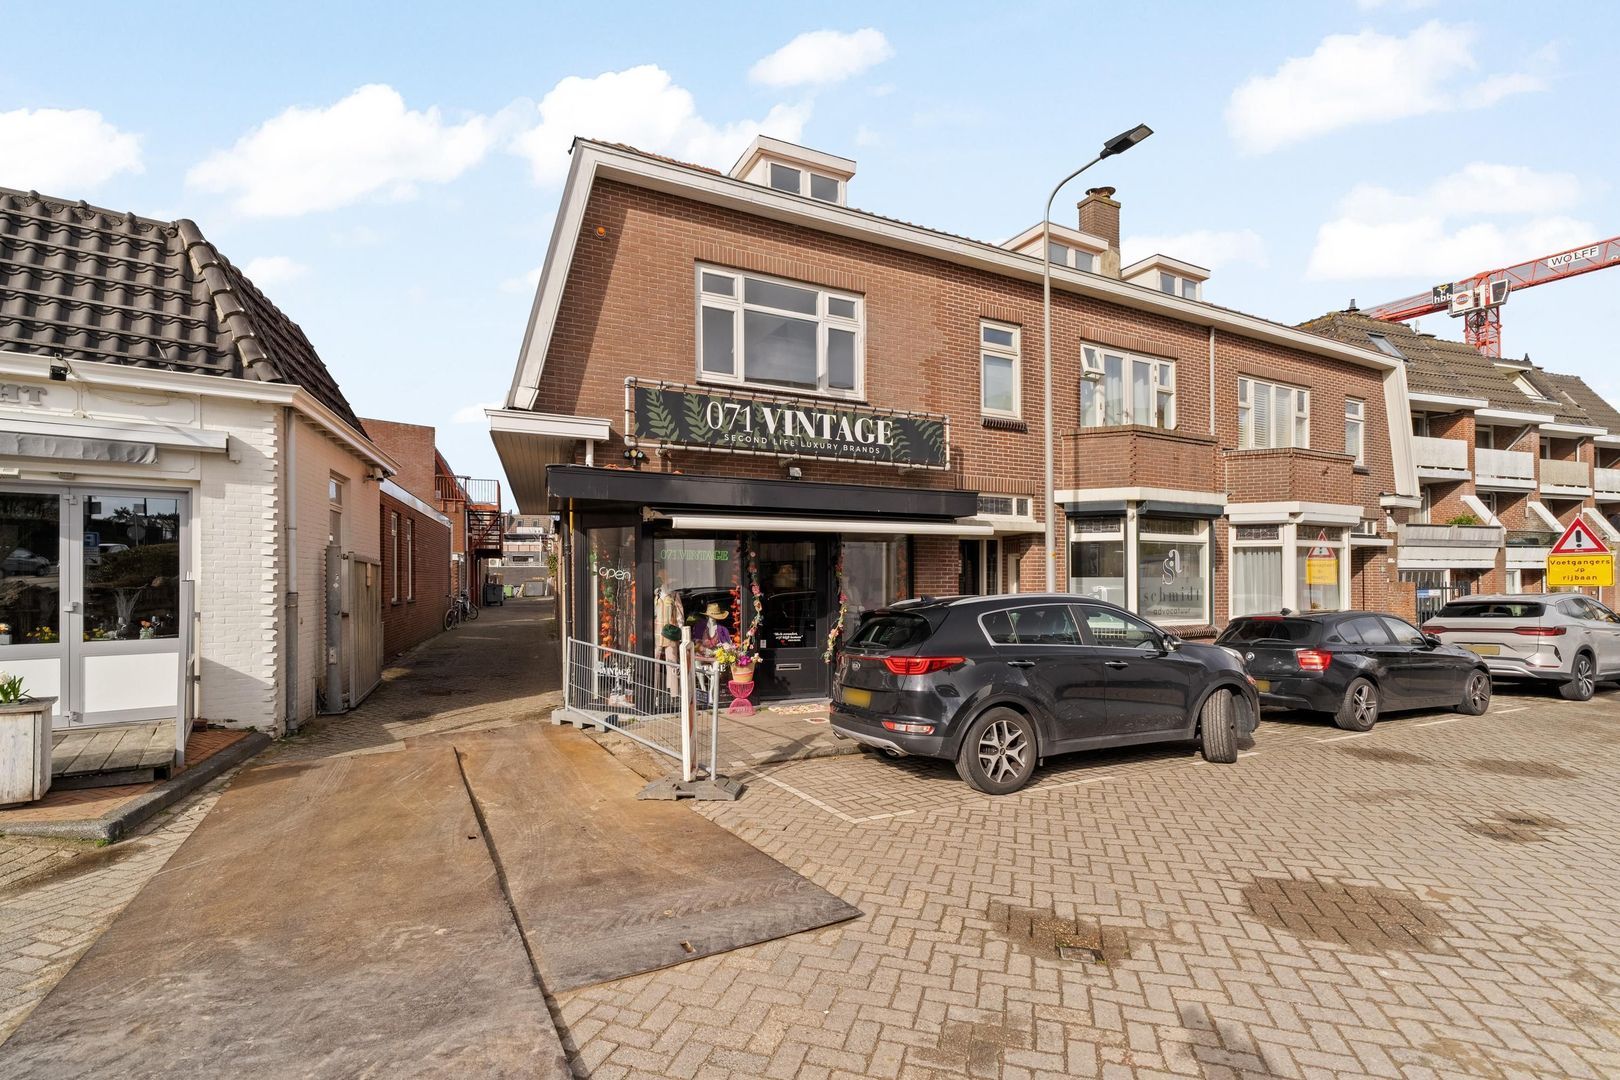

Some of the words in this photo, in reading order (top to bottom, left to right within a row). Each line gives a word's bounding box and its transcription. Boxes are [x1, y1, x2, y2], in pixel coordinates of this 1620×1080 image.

[1551, 247, 1597, 265] WOLFF
[706, 401, 751, 433] 071
[761, 407, 894, 446] VINTAGE
[724, 433, 768, 444] SECOND
[773, 438, 796, 447] LIFE
[801, 441, 839, 451] LUXURY
[843, 445, 881, 454] BRANDS
[681, 550, 729, 561] VINTAGE
[1143, 586, 1199, 602] schmidt
